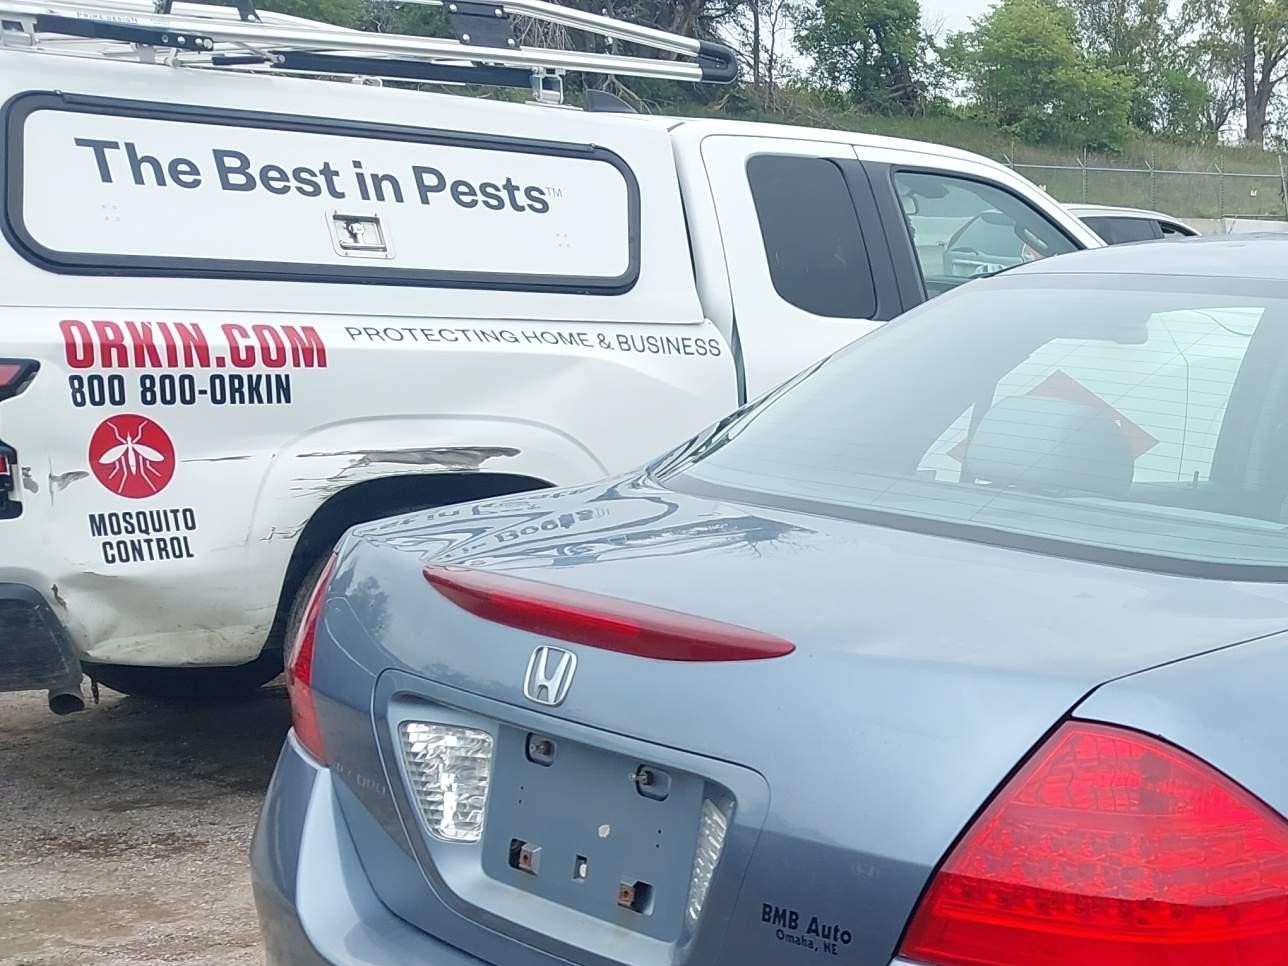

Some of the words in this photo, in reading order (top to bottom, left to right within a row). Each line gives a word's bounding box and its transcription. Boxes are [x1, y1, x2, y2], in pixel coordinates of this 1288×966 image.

[73, 137, 202, 189] The
[212, 148, 346, 199] Best
[352, 160, 404, 203] in
[59, 319, 328, 369] ORKIN.COM
[344, 326, 520, 343] PROTECTING
[525, 330, 594, 348] HOME
[597, 332, 615, 350] &
[617, 333, 722, 357] BUSINESS
[68, 374, 127, 407] 800
[140, 373, 292, 405] 800-ORKIN
[88, 507, 197, 537] MOSQUITO
[102, 536, 194, 564] CONTROL
[761, 902, 799, 930] BMB
[806, 916, 852, 945] Auto
[776, 928, 819, 952] Omaha,
